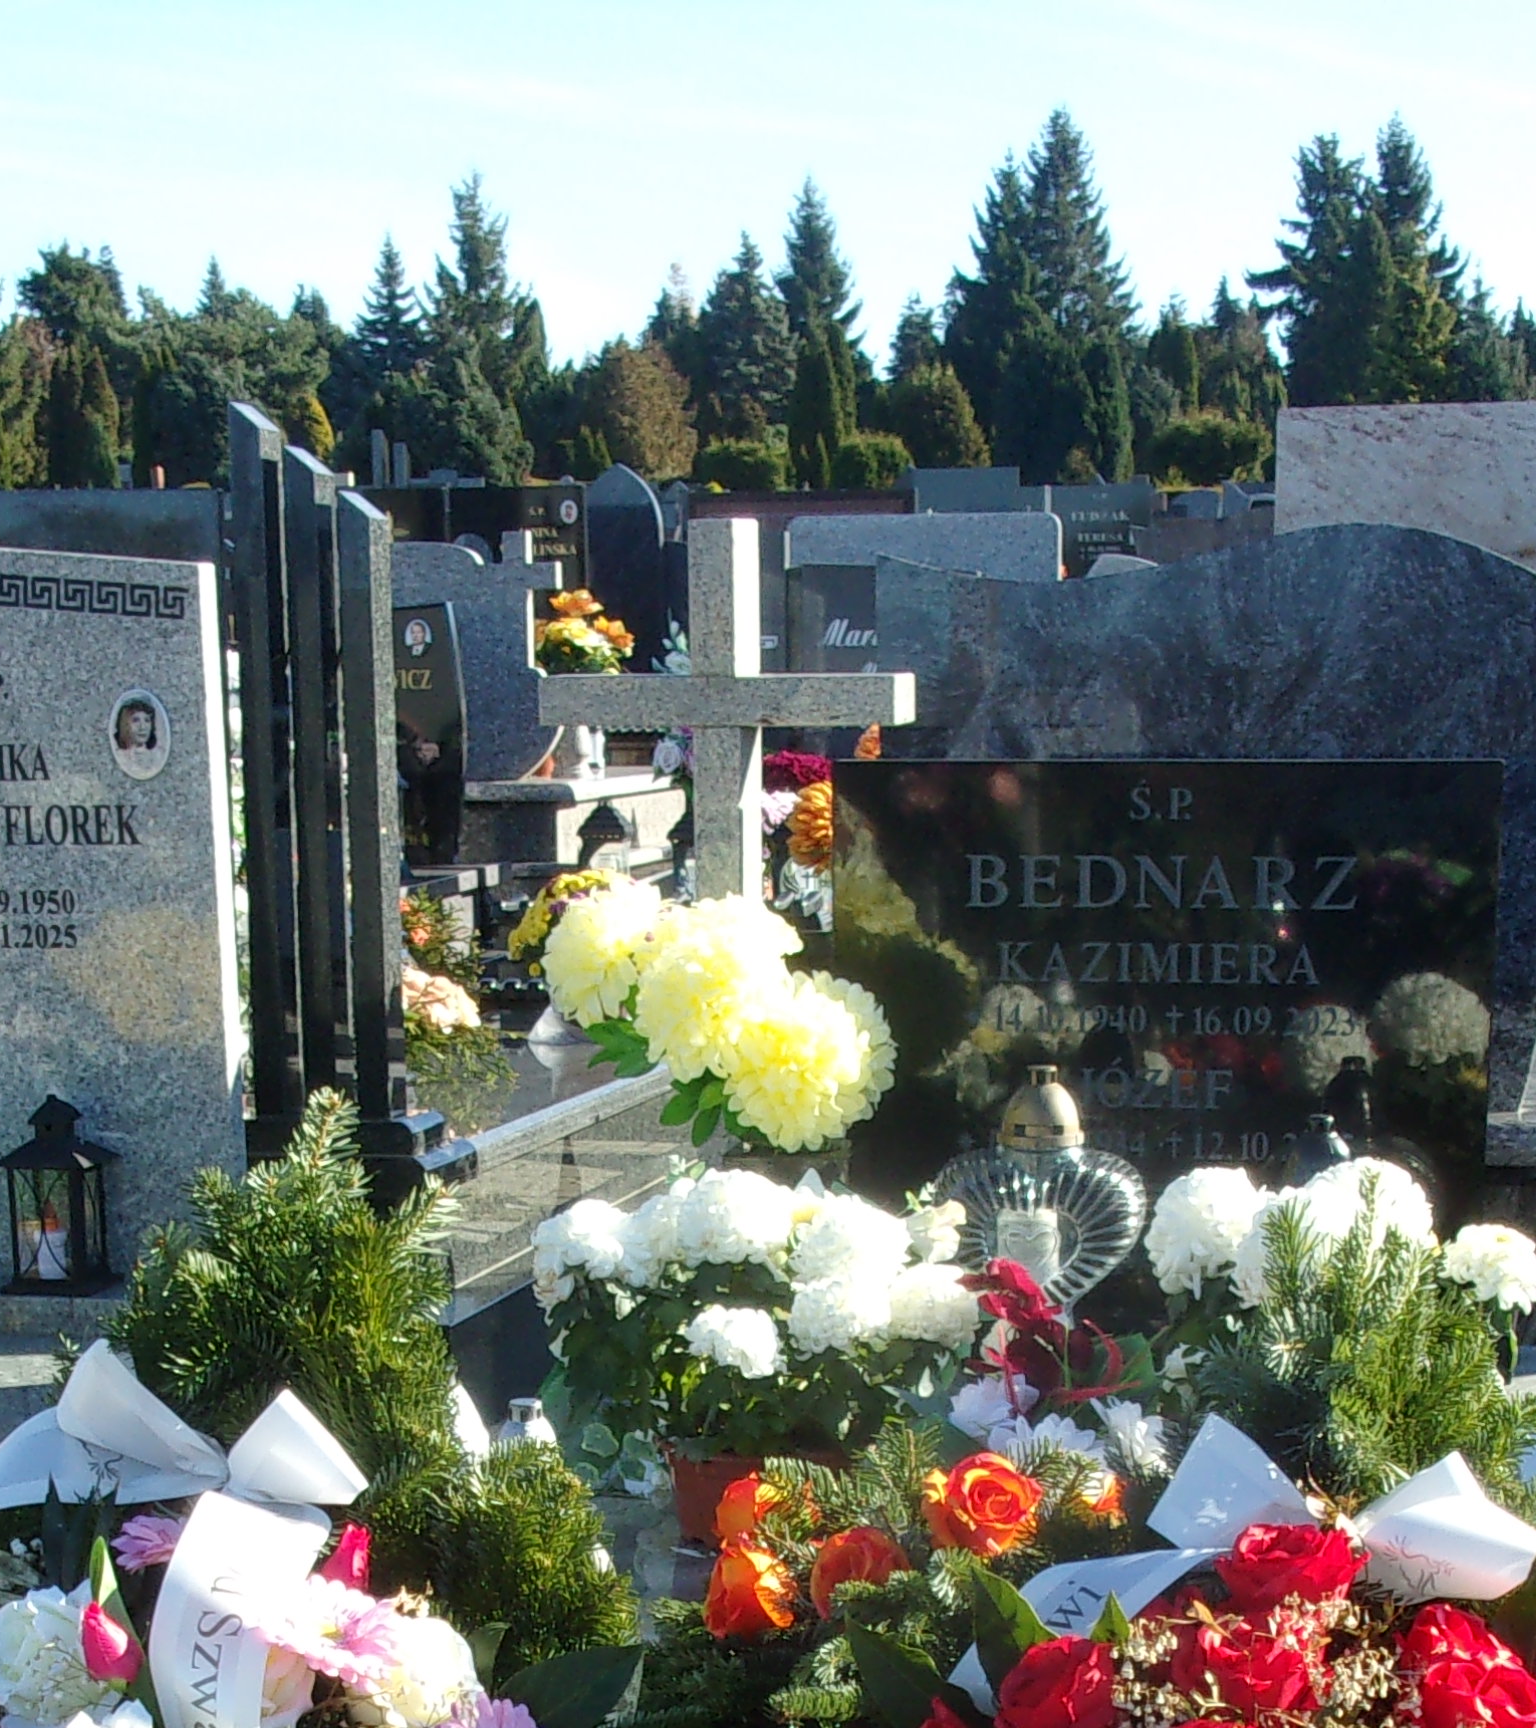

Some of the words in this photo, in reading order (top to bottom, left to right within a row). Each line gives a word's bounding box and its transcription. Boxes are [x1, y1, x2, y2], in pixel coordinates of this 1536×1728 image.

[3, 804, 142, 846] FLOREK
[965, 853, 1359, 911] BEDNARZ
[998, 941, 1321, 986] KAZIMIERA
[1192, 1006, 1358, 1038] 16.09.2023
[1081, 1057, 1234, 1110] JÓZEF
